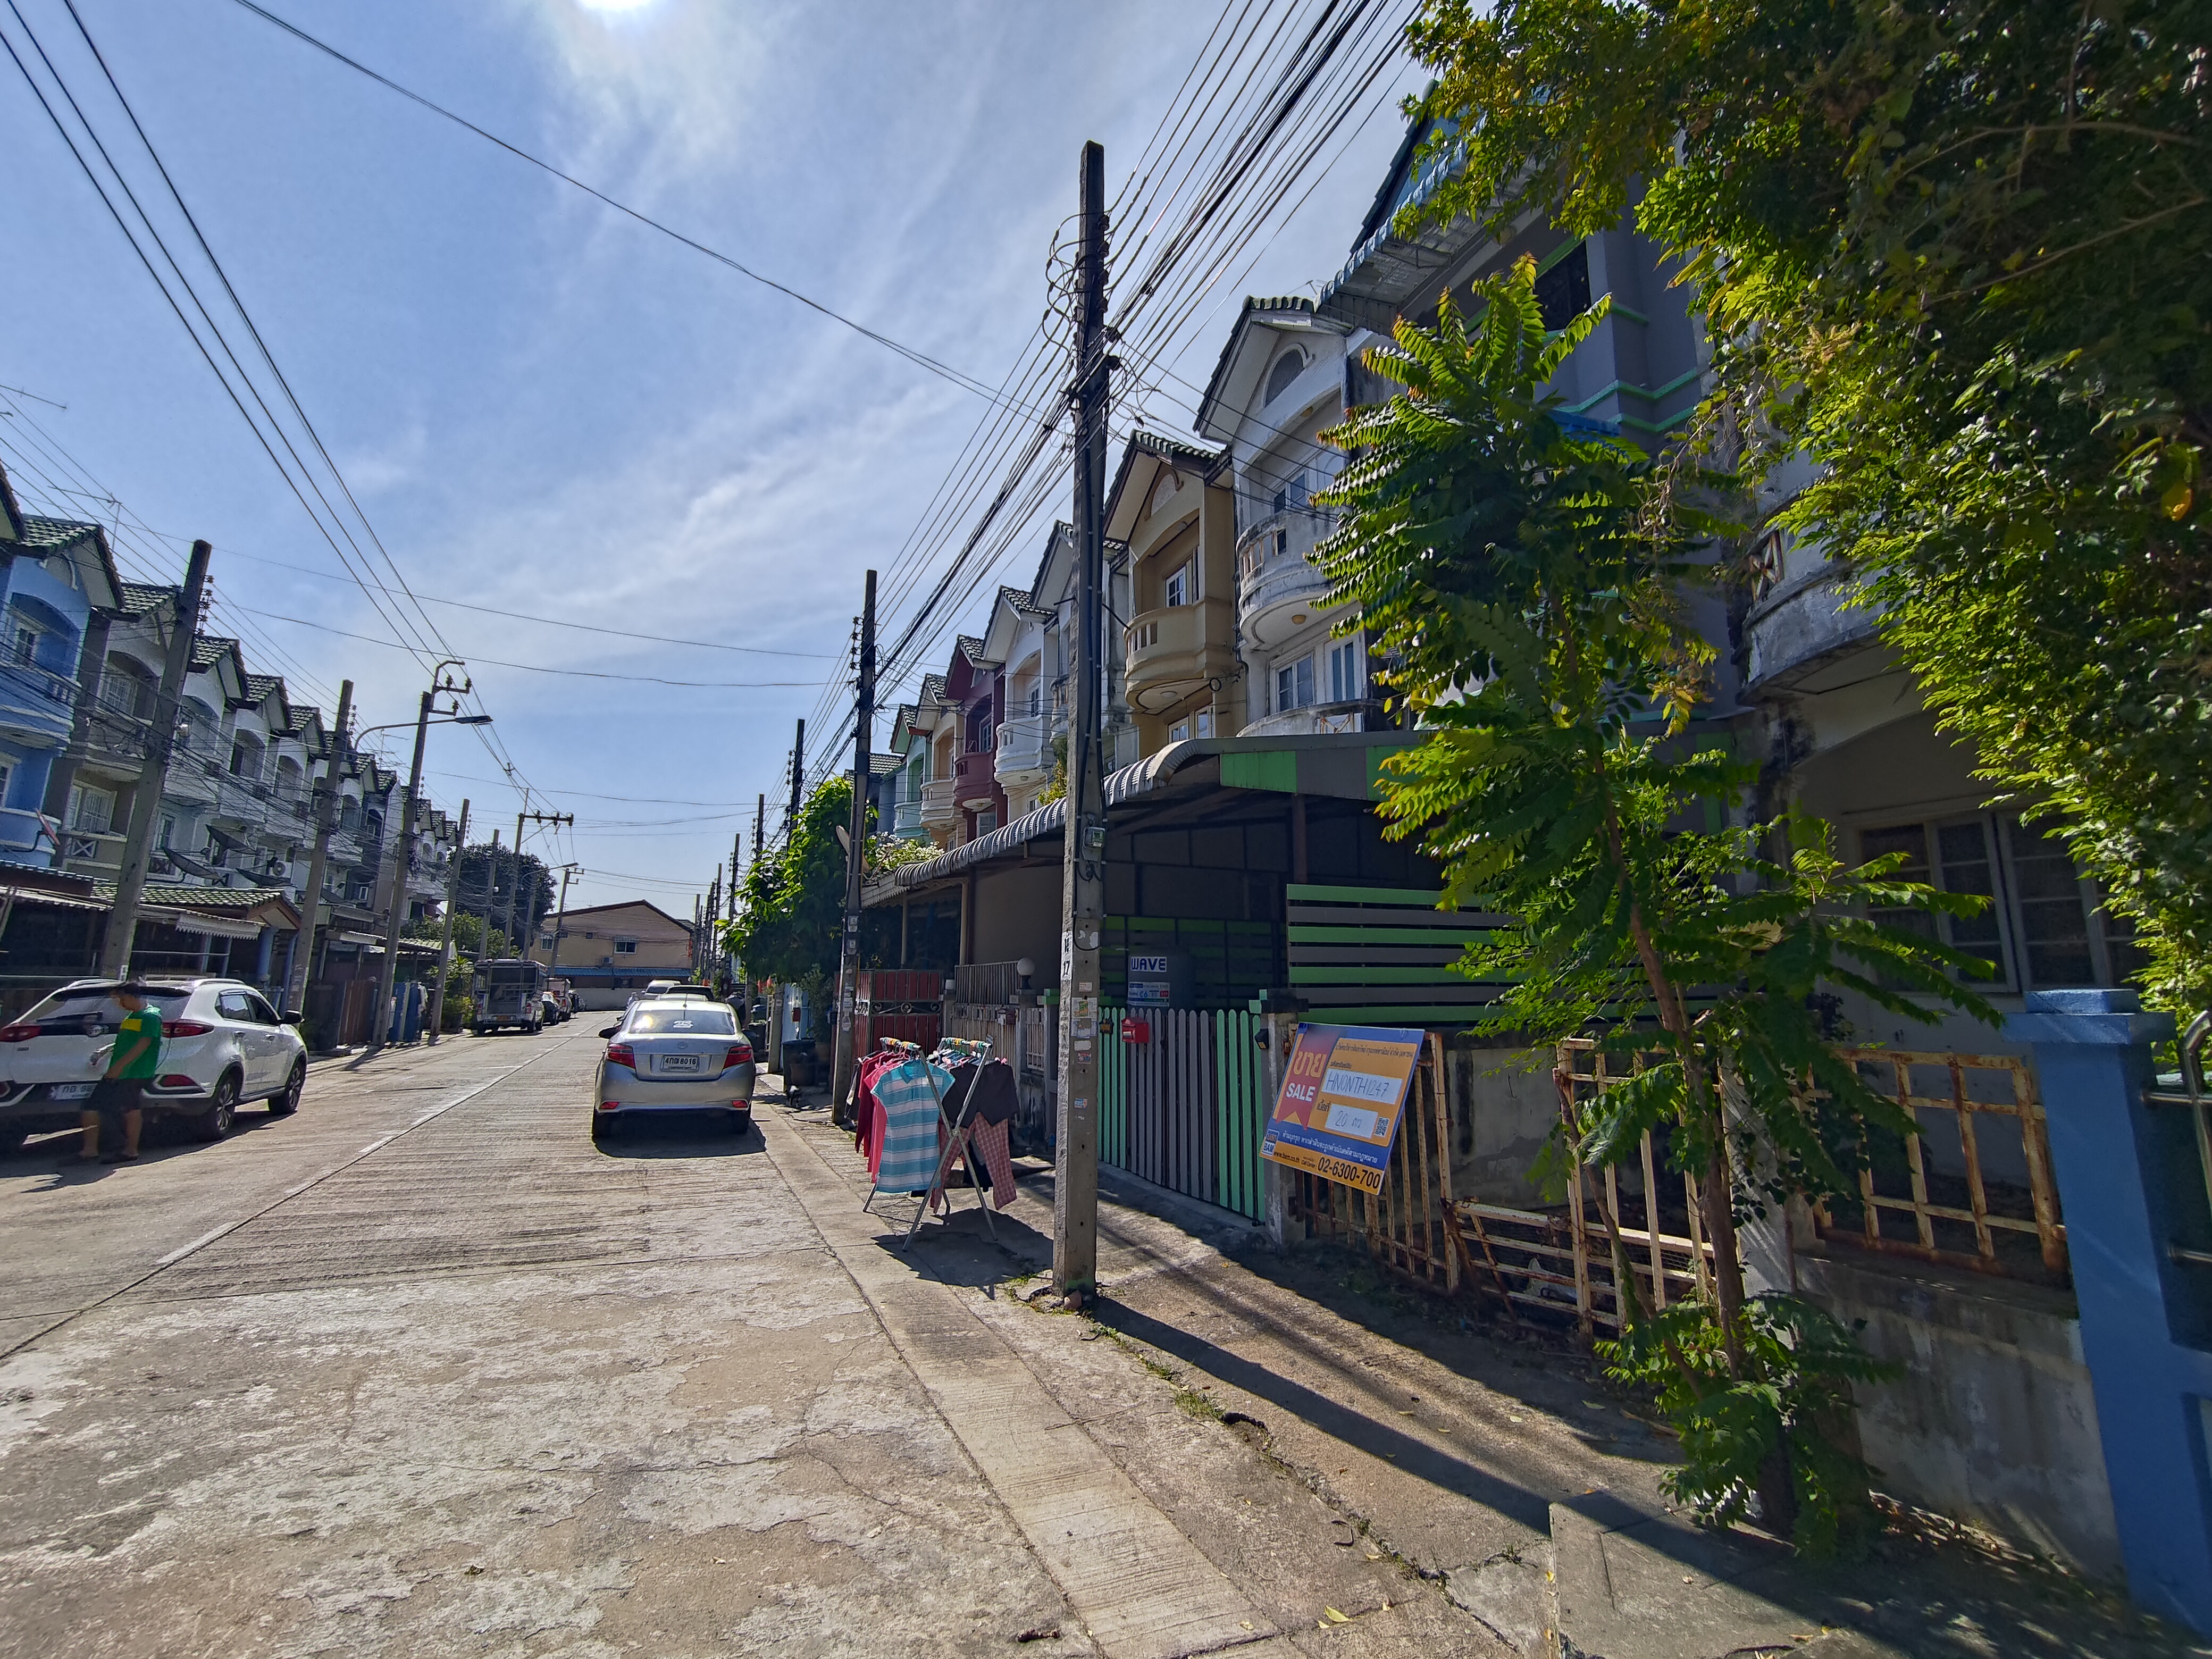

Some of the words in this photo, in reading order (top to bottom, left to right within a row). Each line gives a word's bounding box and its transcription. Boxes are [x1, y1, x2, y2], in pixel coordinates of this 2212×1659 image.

[1131, 958, 1166, 971] WAVE
[1293, 1051, 1327, 1078] ขาย
[1286, 1082, 1316, 1102] SALE
[1263, 1143, 1275, 1153] BAM
[1318, 1157, 1380, 1189] 02-6300-700
